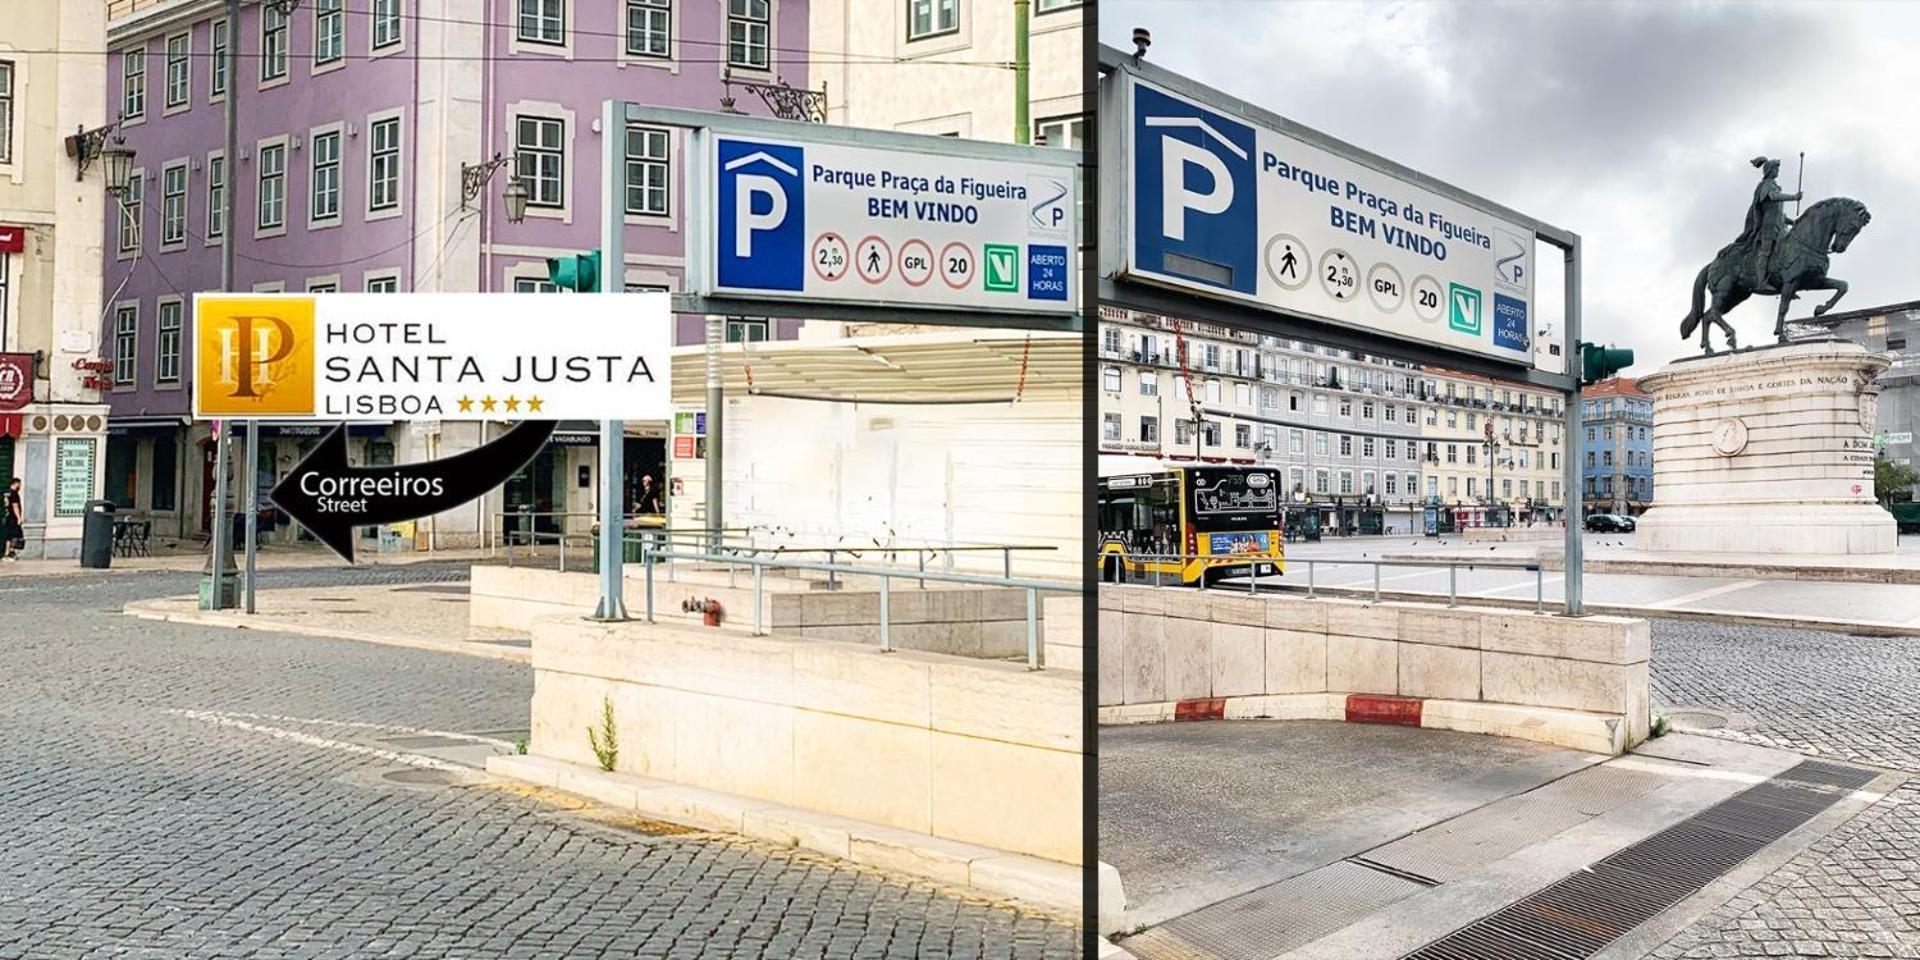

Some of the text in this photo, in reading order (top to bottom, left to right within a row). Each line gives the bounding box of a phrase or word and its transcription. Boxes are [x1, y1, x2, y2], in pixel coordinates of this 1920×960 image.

[812, 165, 1027, 201] Parque Praça da Figueira
[1162, 134, 1234, 241] P
[1263, 152, 1491, 249] Parque Praça da Figueira
[736, 174, 788, 258] P
[868, 198, 978, 225] BEM VINDO
[1052, 208, 1064, 227] P
[1330, 206, 1447, 262] BEM VINDO
[904, 256, 928, 270] GPL
[949, 258, 968, 274] 20
[1030, 254, 1066, 266] ABERTO
[1042, 268, 1053, 278] 24
[1513, 265, 1523, 283] P
[1032, 280, 1064, 292] HORAS
[1374, 279, 1398, 298] GPL
[1419, 289, 1438, 308] 20
[1496, 303, 1526, 319] ABERTO
[1506, 318, 1516, 327] 24
[1800, 377, 1812, 385] DA
[1843, 440, 1849, 449] A
